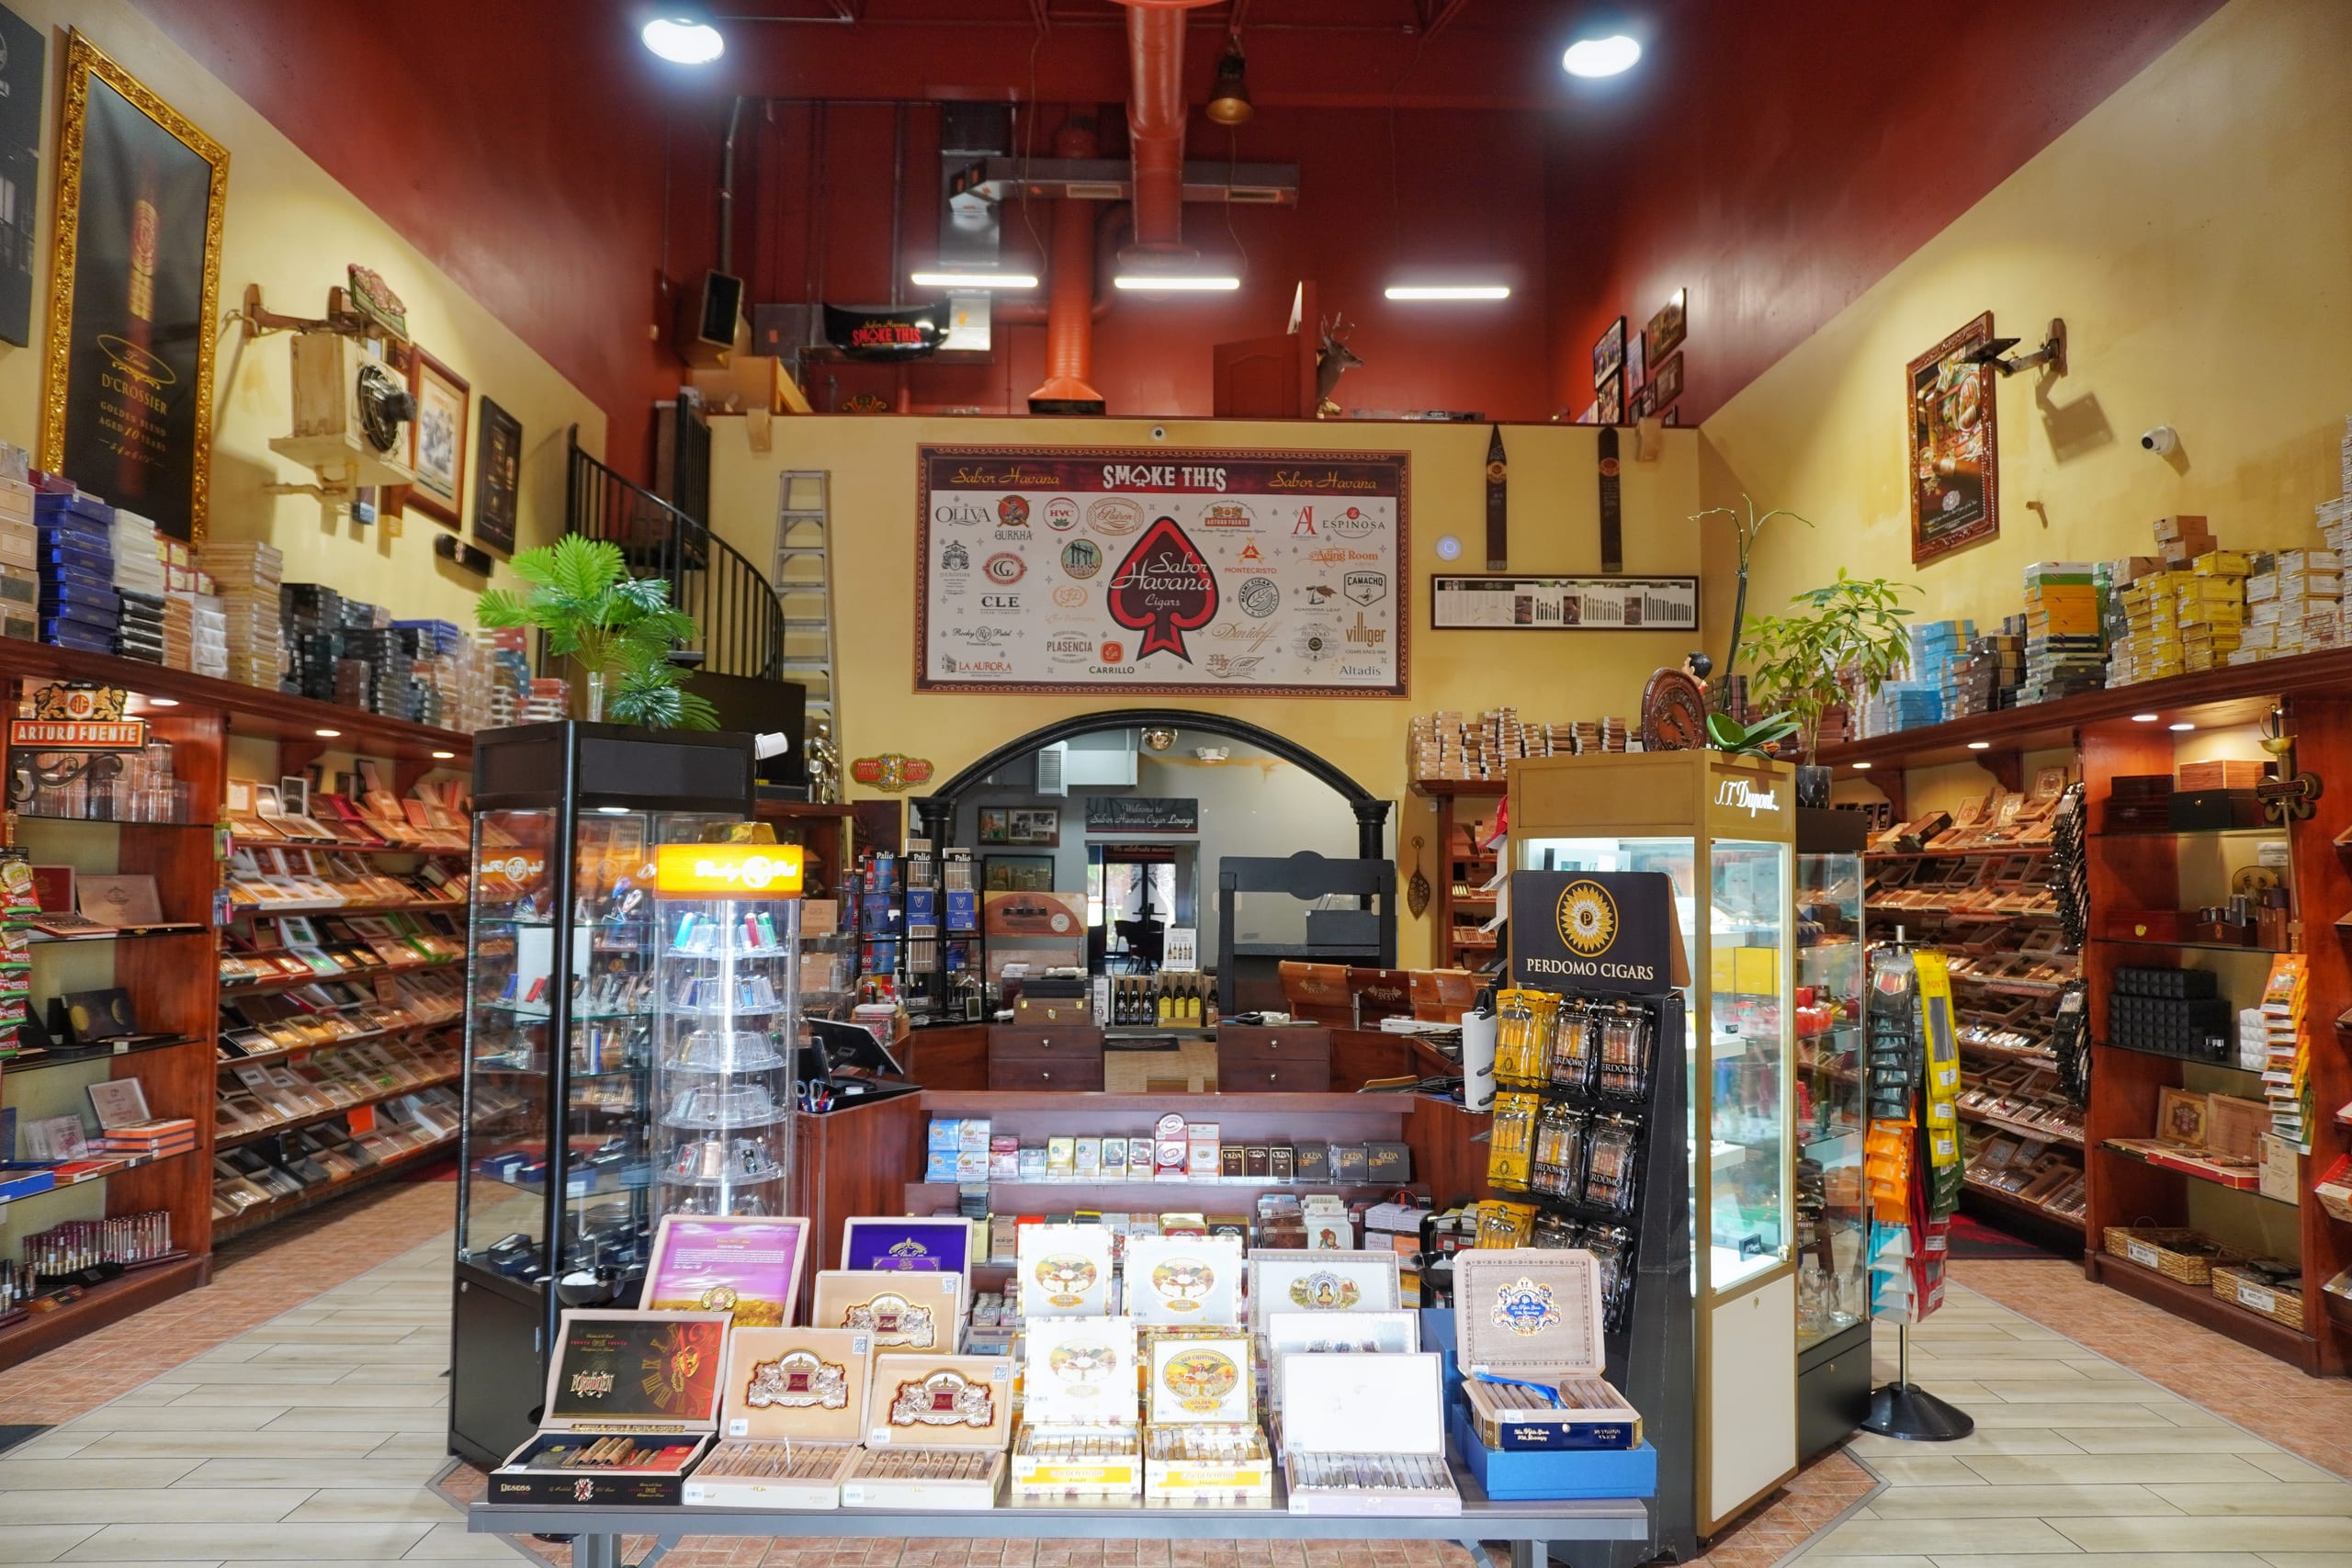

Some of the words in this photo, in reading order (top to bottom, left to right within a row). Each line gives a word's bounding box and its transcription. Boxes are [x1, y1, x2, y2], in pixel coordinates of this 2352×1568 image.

[895, 327, 922, 344] THIS
[101, 373, 168, 415] D'CROSSIER
[99, 400, 138, 423] GOLDEN
[97, 416, 124, 433] AGED
[124, 427, 139, 440] 10
[950, 467, 996, 484] Sabor
[998, 466, 1060, 485] Havana
[1182, 467, 1227, 492] THIS
[1268, 470, 1314, 489] Sabor
[1316, 470, 1378, 490] Havana
[935, 506, 991, 524] OLIVA
[1049, 509, 1073, 517] HVC
[1322, 520, 1386, 530] ESPINOSA
[994, 529, 1034, 541] GURKHA
[1148, 551, 1210, 574] Sabor
[1314, 549, 1346, 563] Aging
[1348, 550, 1378, 560] Room
[1109, 562, 1213, 591] Havana
[1224, 566, 1278, 575] MONTECRISTO
[1347, 575, 1384, 586] CAMACHO
[1240, 581, 1250, 603] MIAMI
[981, 596, 1020, 608] CLE
[1145, 592, 1181, 611] Cigars
[1212, 621, 1277, 653] Davidoff
[1346, 611, 1386, 648] villiger
[1046, 640, 1093, 653] PLASENCIA
[958, 661, 971, 671] LA
[973, 661, 1012, 671] AURORA
[1089, 666, 1135, 674] CARRILLO
[1339, 665, 1382, 675] Altadis
[17, 724, 75, 741] ARTURO
[78, 725, 137, 742] FUENTE
[1736, 780, 1780, 818] Dupont
[1122, 804, 1154, 813] Welcome
[1090, 813, 1114, 824] Sabor
[1114, 813, 1146, 824] Havana
[1146, 813, 1166, 828] Cigar
[1166, 814, 1194, 828] Lounge
[876, 851, 894, 860] Palio
[913, 852, 931, 862] Palio
[955, 854, 971, 863] Palio
[1526, 958, 1598, 976] PERDOMO
[1600, 963, 1655, 980] CIGARS
[1554, 1056, 1588, 1068] ERDOMO
[1601, 1063, 1639, 1074] ERDOMO
[1534, 1162, 1570, 1175] ERDOMO
[1589, 1172, 1623, 1187] ERDOMO
